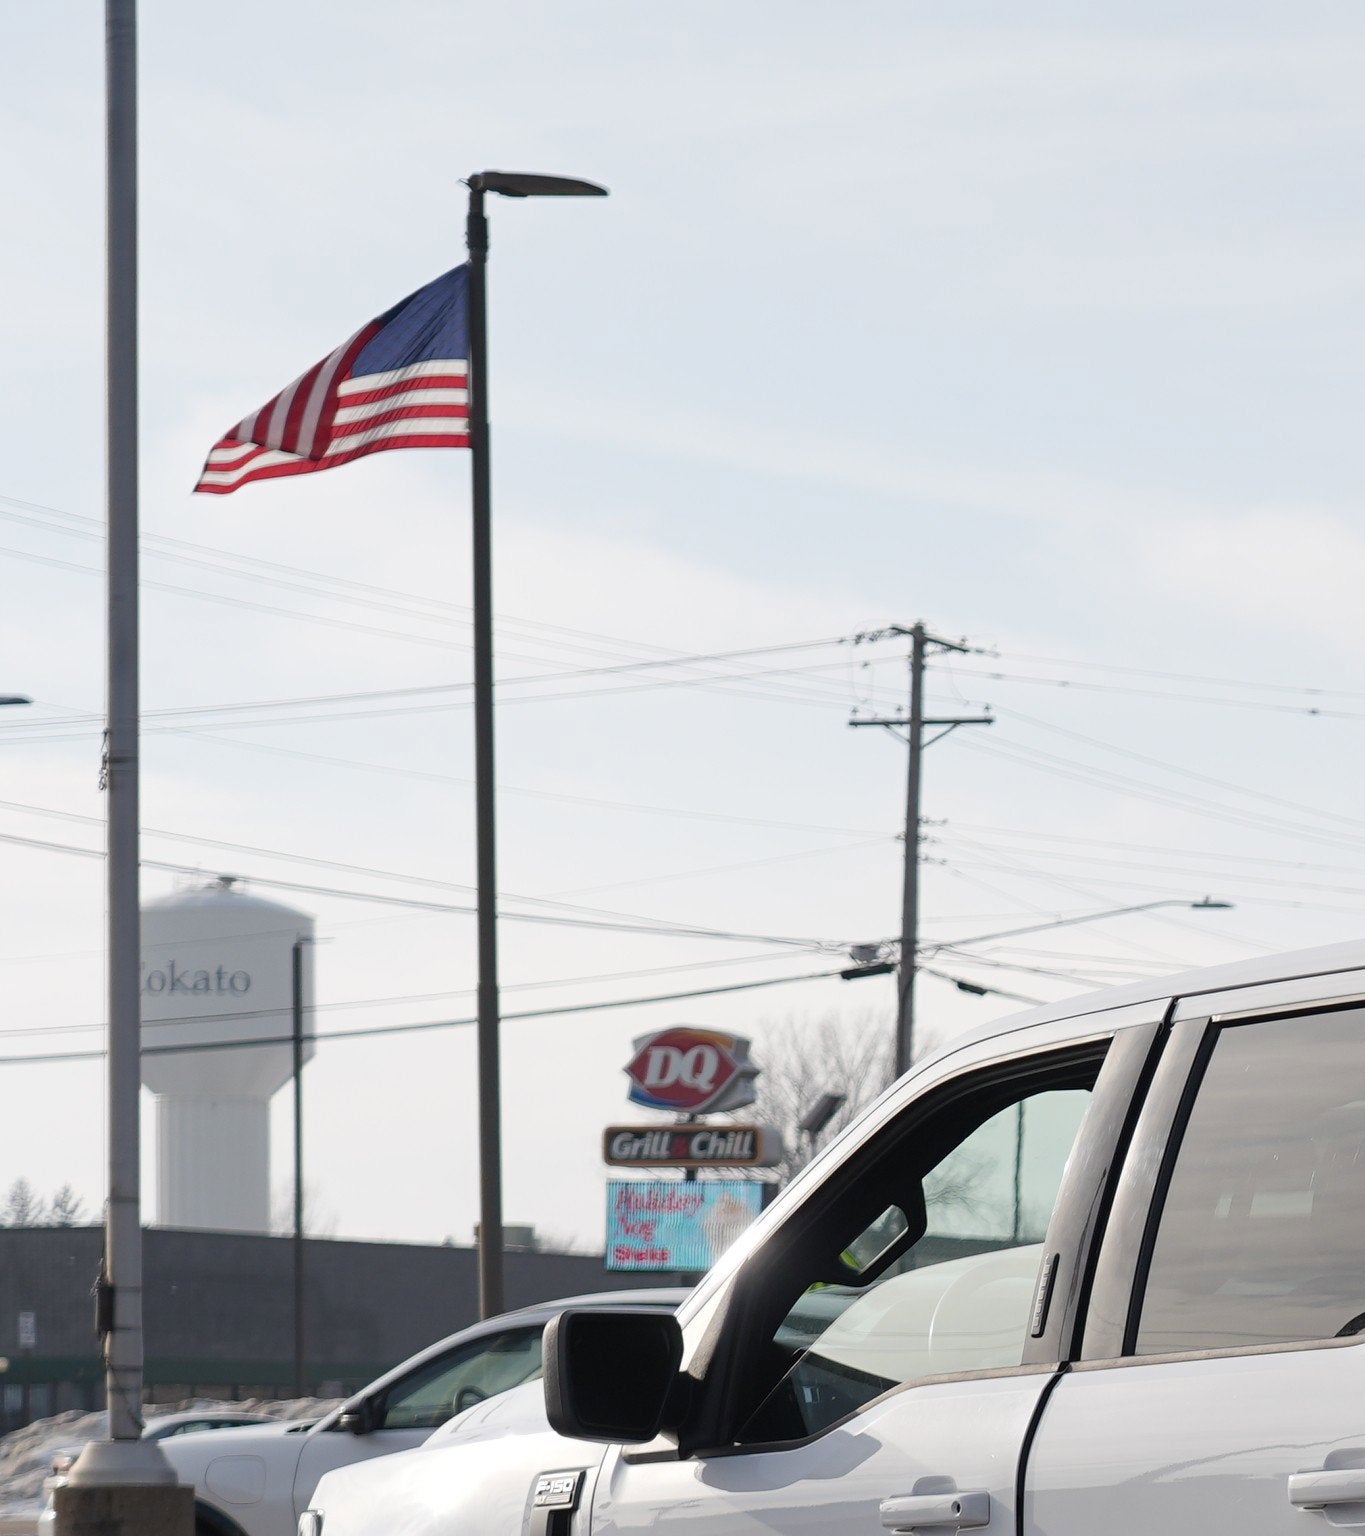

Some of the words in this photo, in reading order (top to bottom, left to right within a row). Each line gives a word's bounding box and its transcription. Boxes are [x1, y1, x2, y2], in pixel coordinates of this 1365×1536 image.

[140, 959, 251, 996] okato
[644, 1043, 719, 1092] DQ
[612, 1132, 670, 1159] Grill
[690, 1131, 752, 1159] Chill
[535, 1478, 574, 1495] F-150
